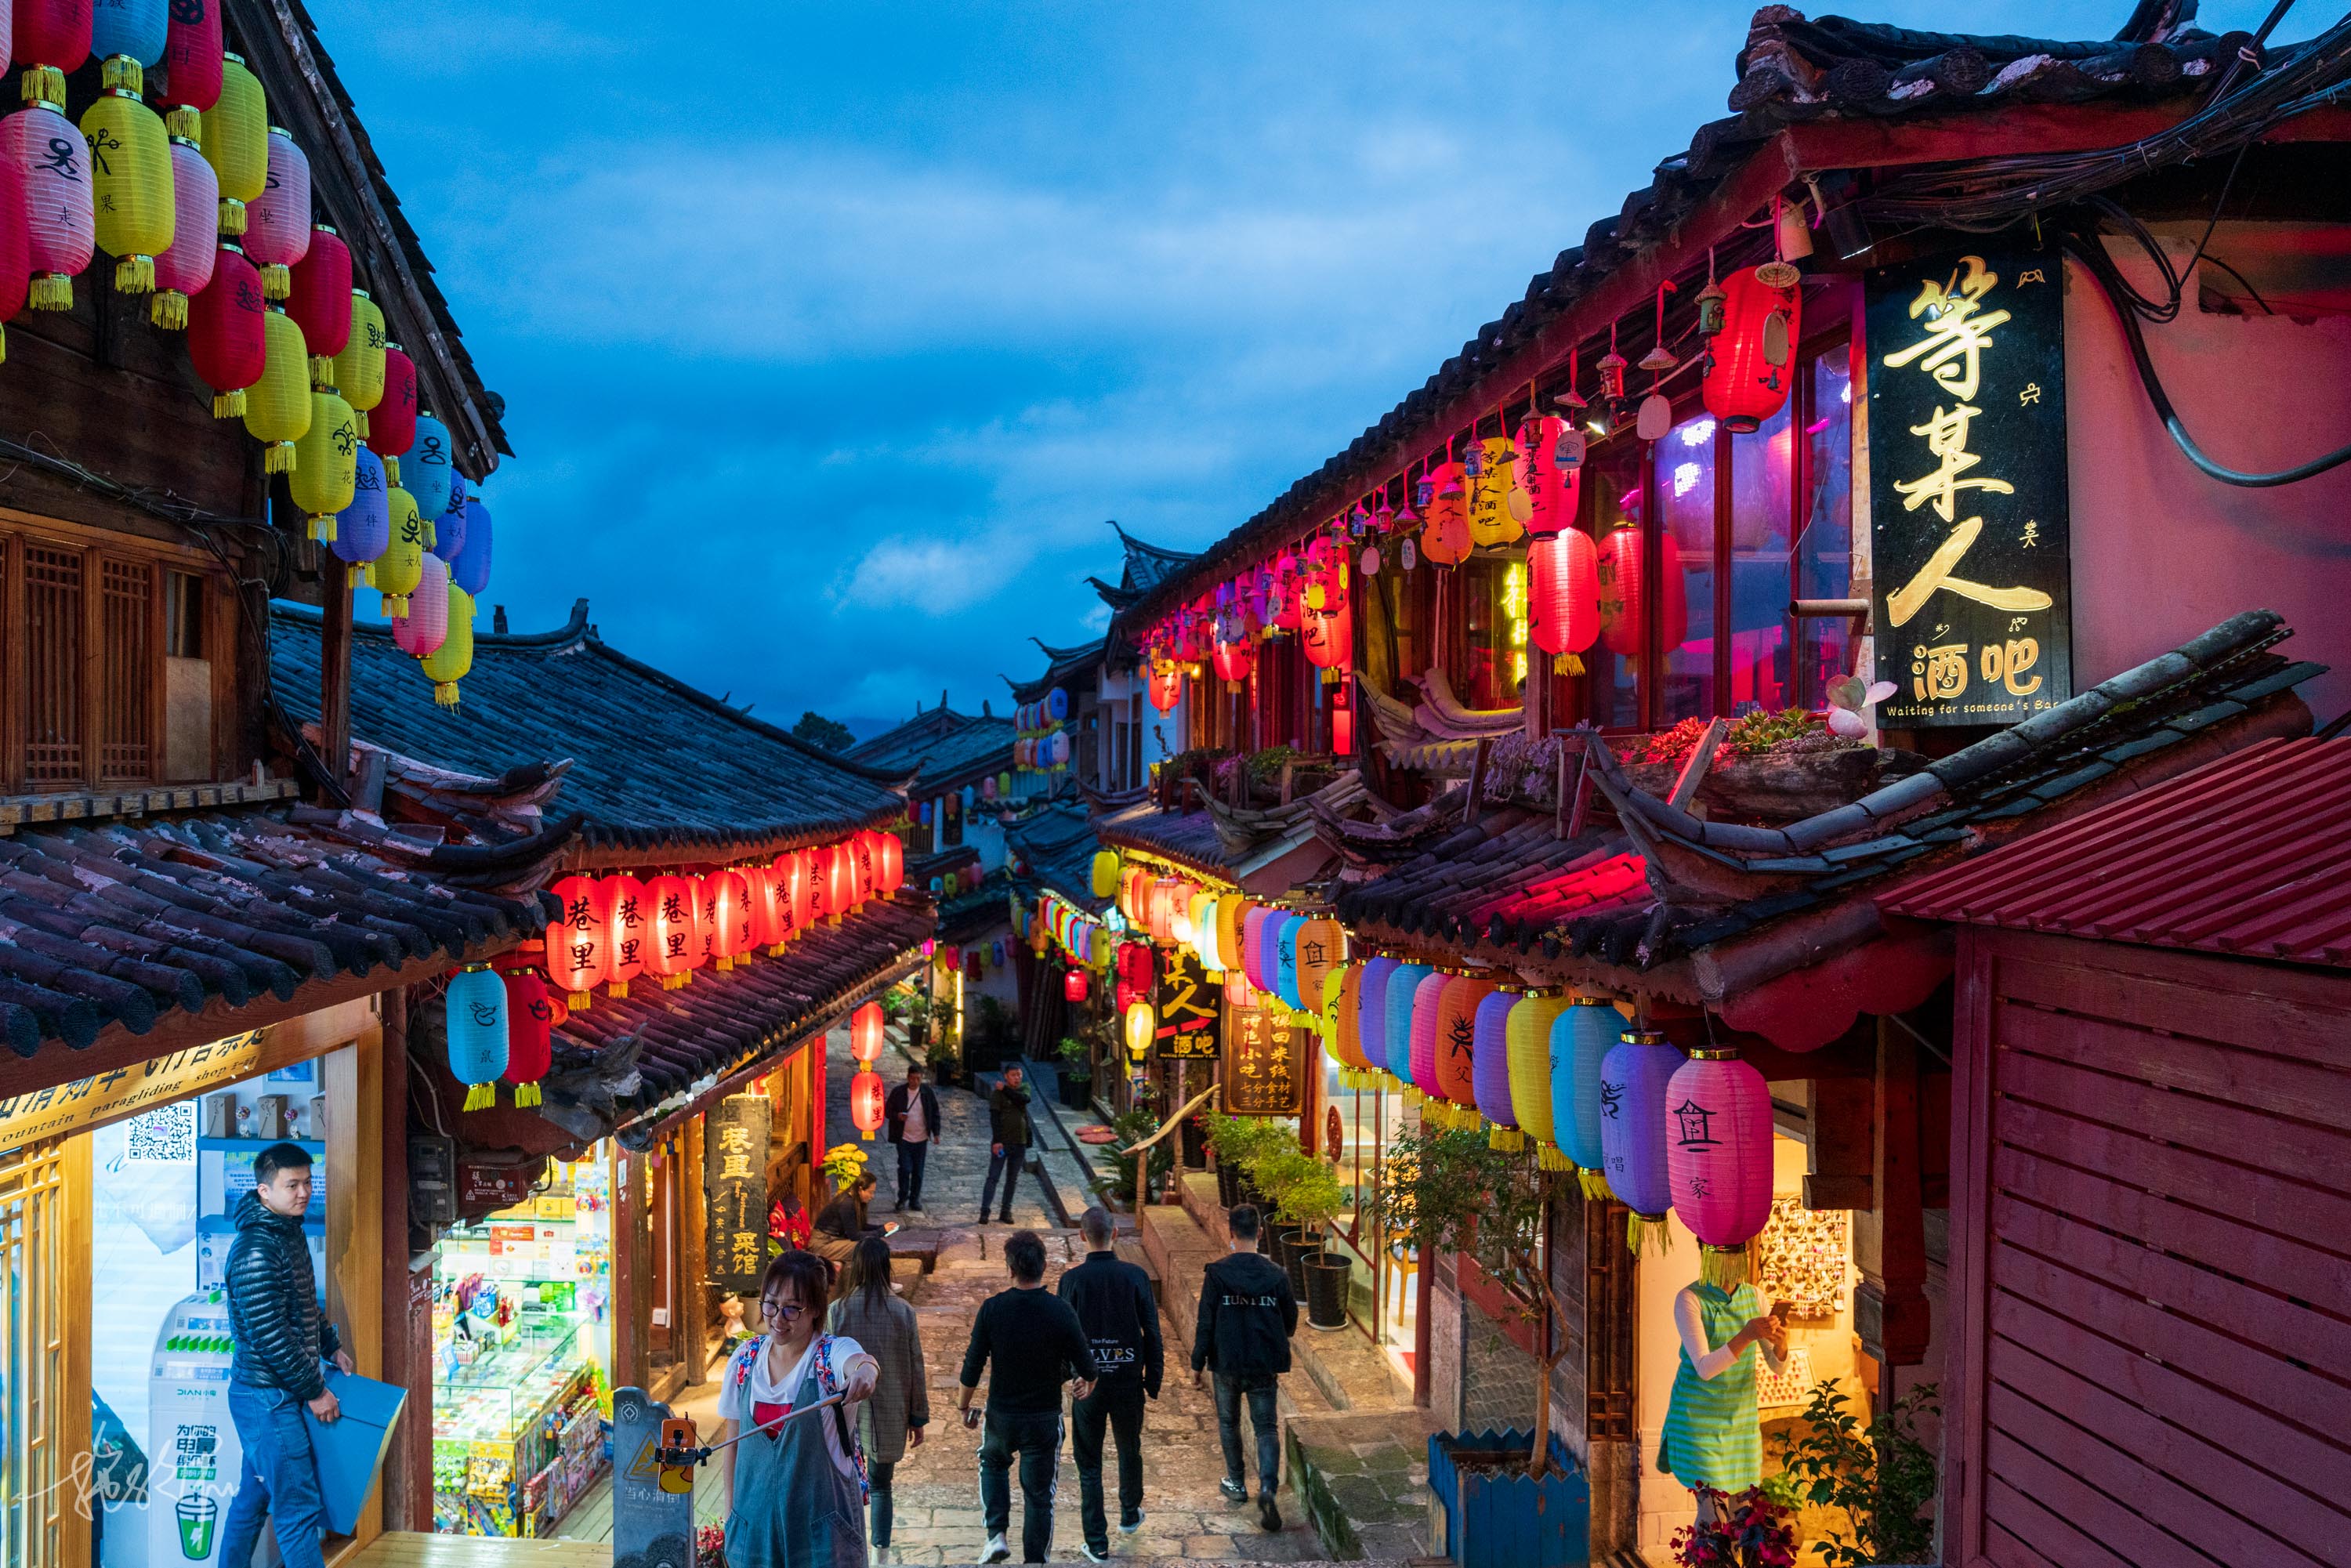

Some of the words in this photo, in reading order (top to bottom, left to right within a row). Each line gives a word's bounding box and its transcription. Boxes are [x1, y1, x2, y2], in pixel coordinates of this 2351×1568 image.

[57, 206, 76, 226] 走
[100, 194, 117, 214] 果
[1883, 255, 2053, 628] 等某人
[1911, 636, 2043, 702] 酒吧
[1886, 706, 1935, 717] Waiting
[1940, 703, 1958, 715] for
[565, 896, 601, 972] 巷里
[618, 896, 645, 967] 巷里
[661, 893, 690, 959] 巷里
[1162, 951, 1218, 1019] 某人
[90, 1078, 183, 1118] paragliding
[195, 1066, 227, 1083] shop
[1455, 1066, 1473, 1083] 父
[719, 1127, 755, 1179] 巷里
[1689, 1176, 1712, 1200] 家
[731, 1231, 760, 1275] 菜馆
